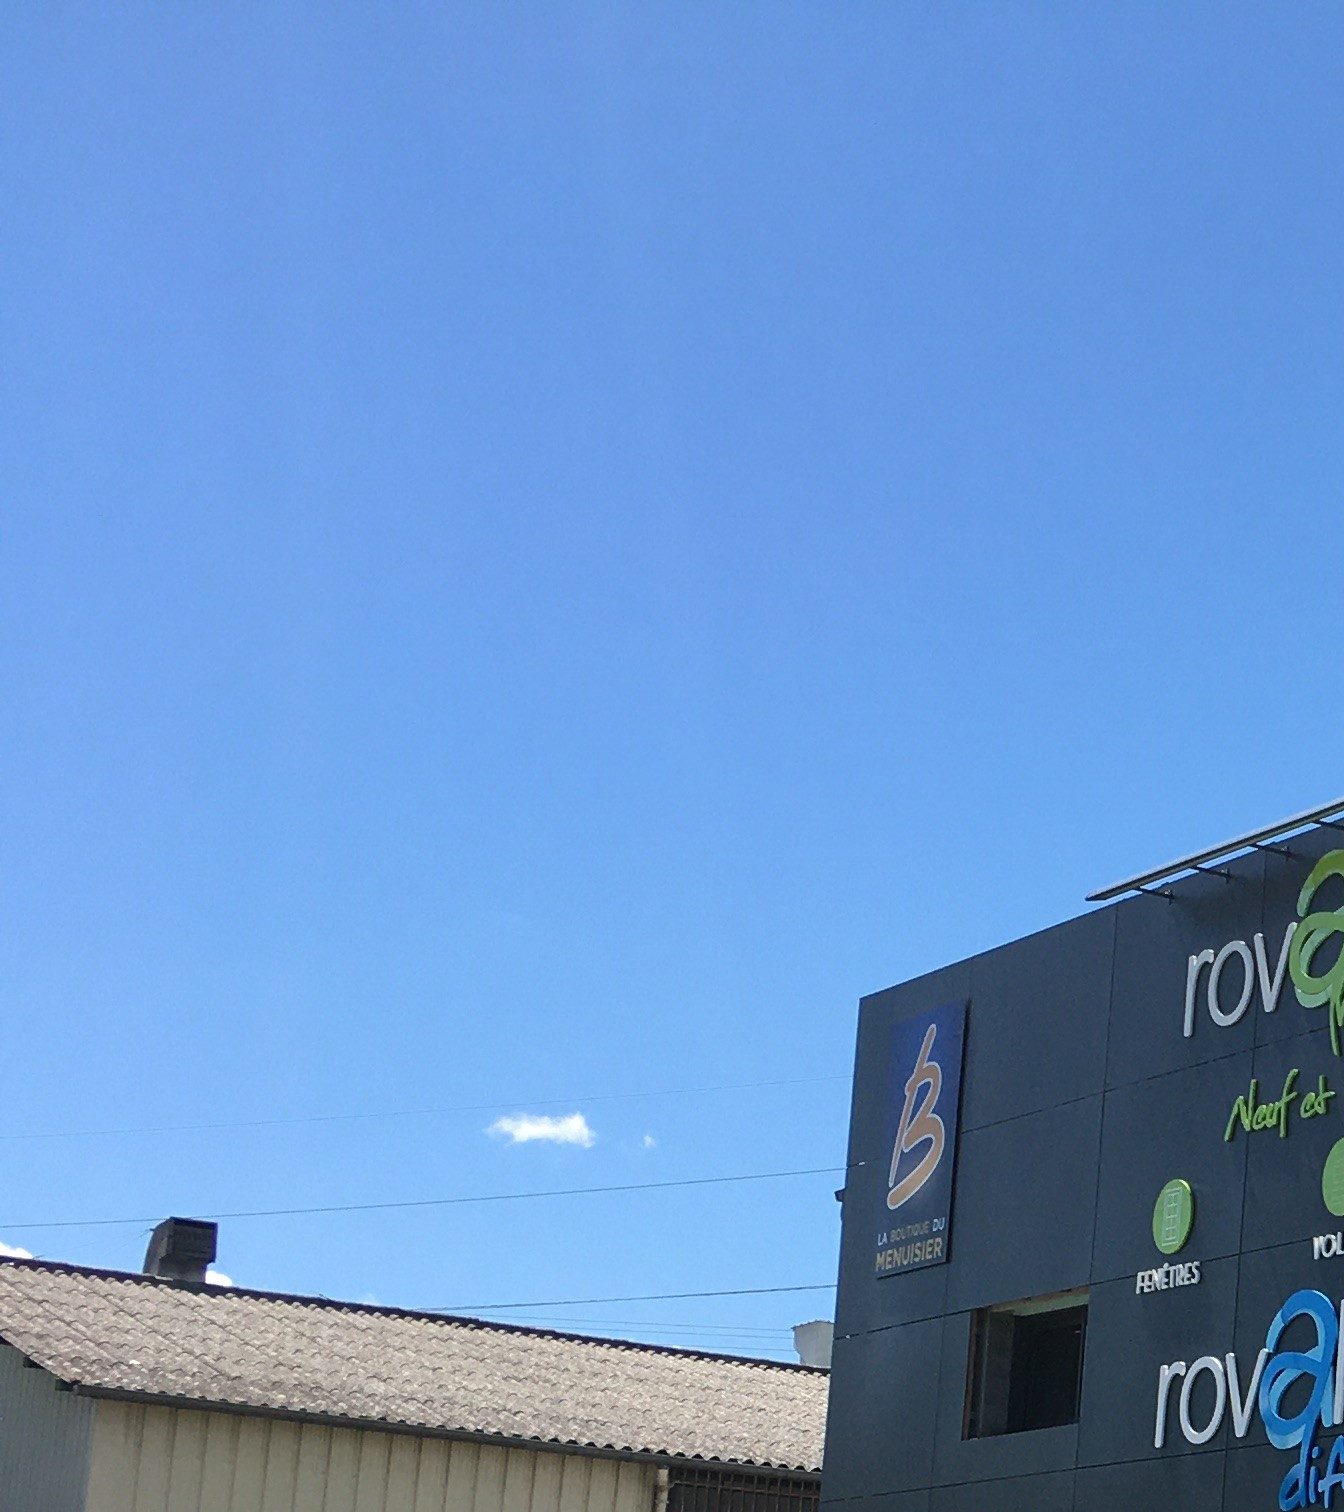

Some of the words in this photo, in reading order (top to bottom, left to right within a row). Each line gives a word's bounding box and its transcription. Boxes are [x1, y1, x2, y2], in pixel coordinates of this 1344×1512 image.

[1224, 1068, 1300, 1142] Neuf
[1300, 1074, 1336, 1119] et
[877, 1232, 888, 1246] LA
[932, 1217, 945, 1232] DU
[875, 1237, 943, 1272] MENUISIER
